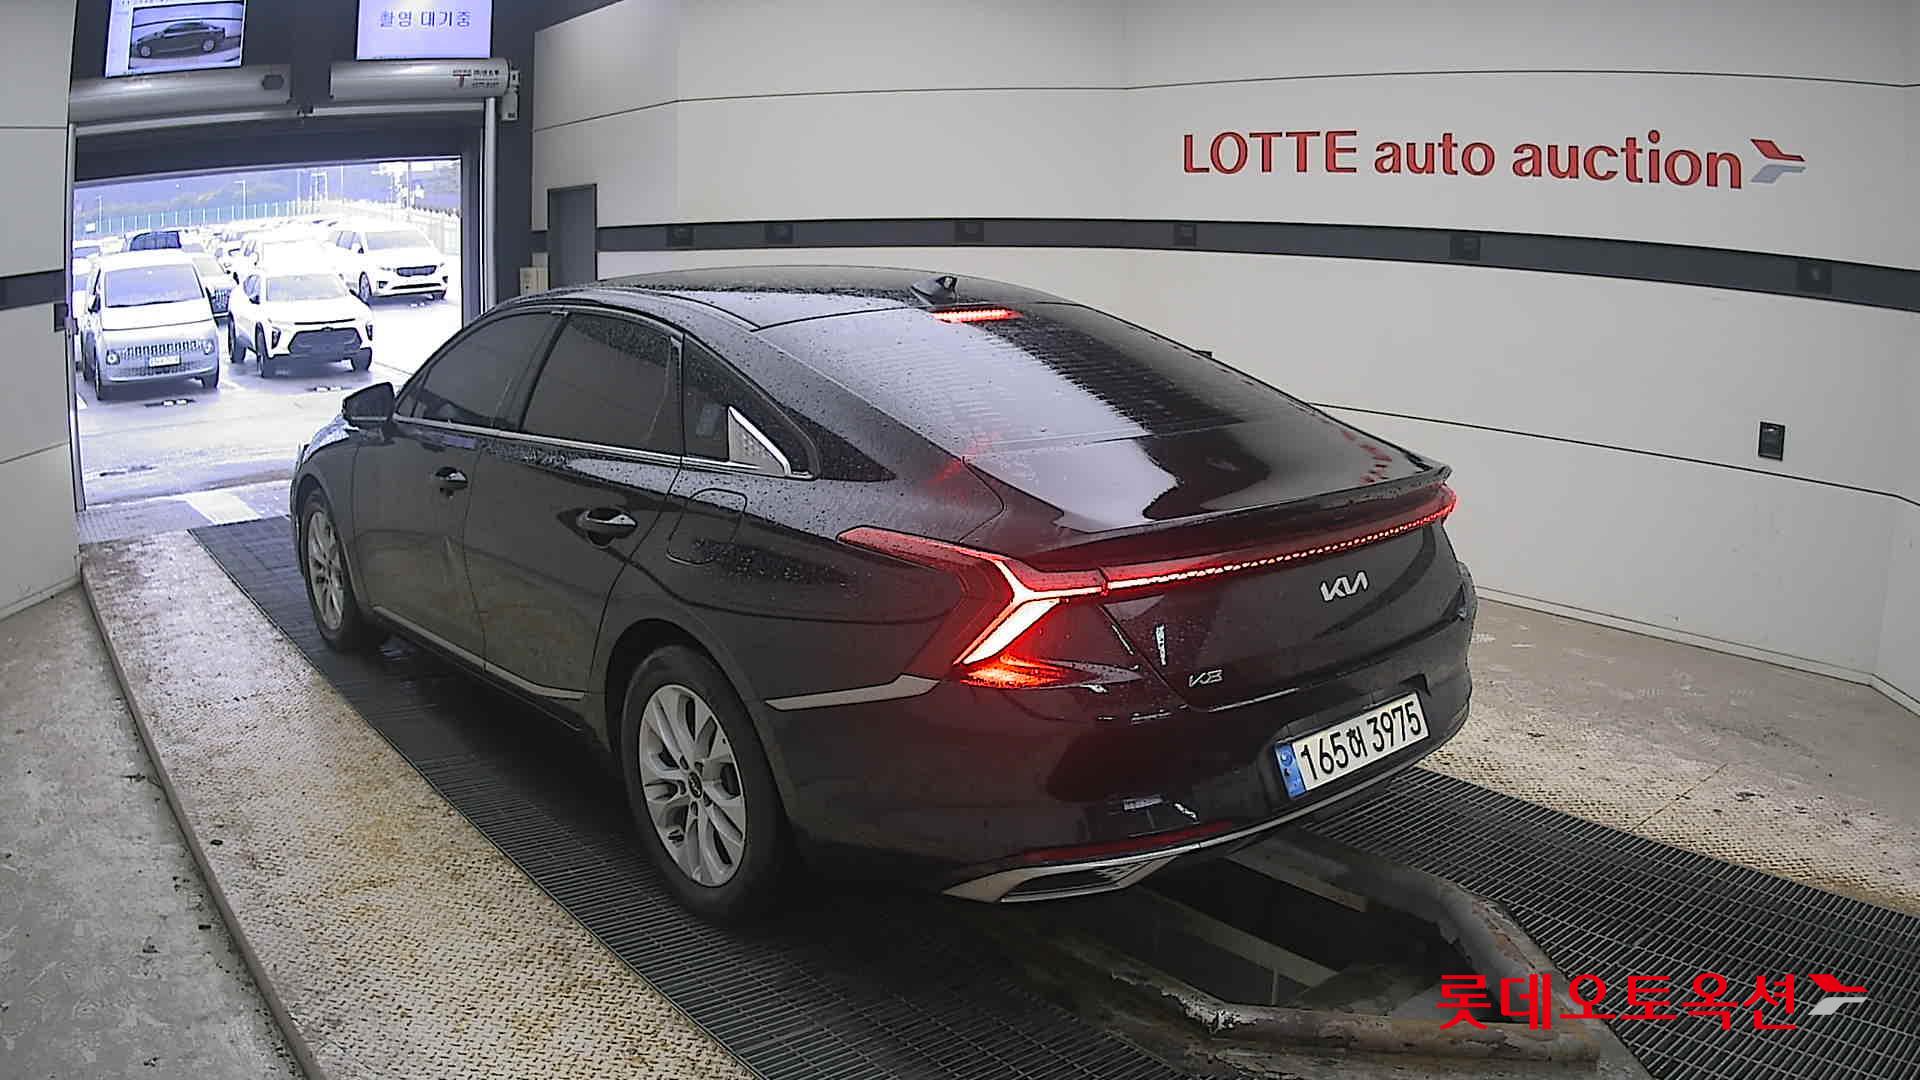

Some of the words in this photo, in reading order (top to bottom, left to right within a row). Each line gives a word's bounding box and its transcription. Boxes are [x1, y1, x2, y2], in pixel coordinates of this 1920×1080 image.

[421, 10, 470, 28] 대기중
[1183, 130, 1358, 175] LOTTE
[1374, 132, 1496, 177] auto
[1511, 129, 1743, 190] auction
[1319, 570, 1369, 602] KIA
[1300, 726, 1368, 781] 165허
[1366, 701, 1422, 752] 3975
